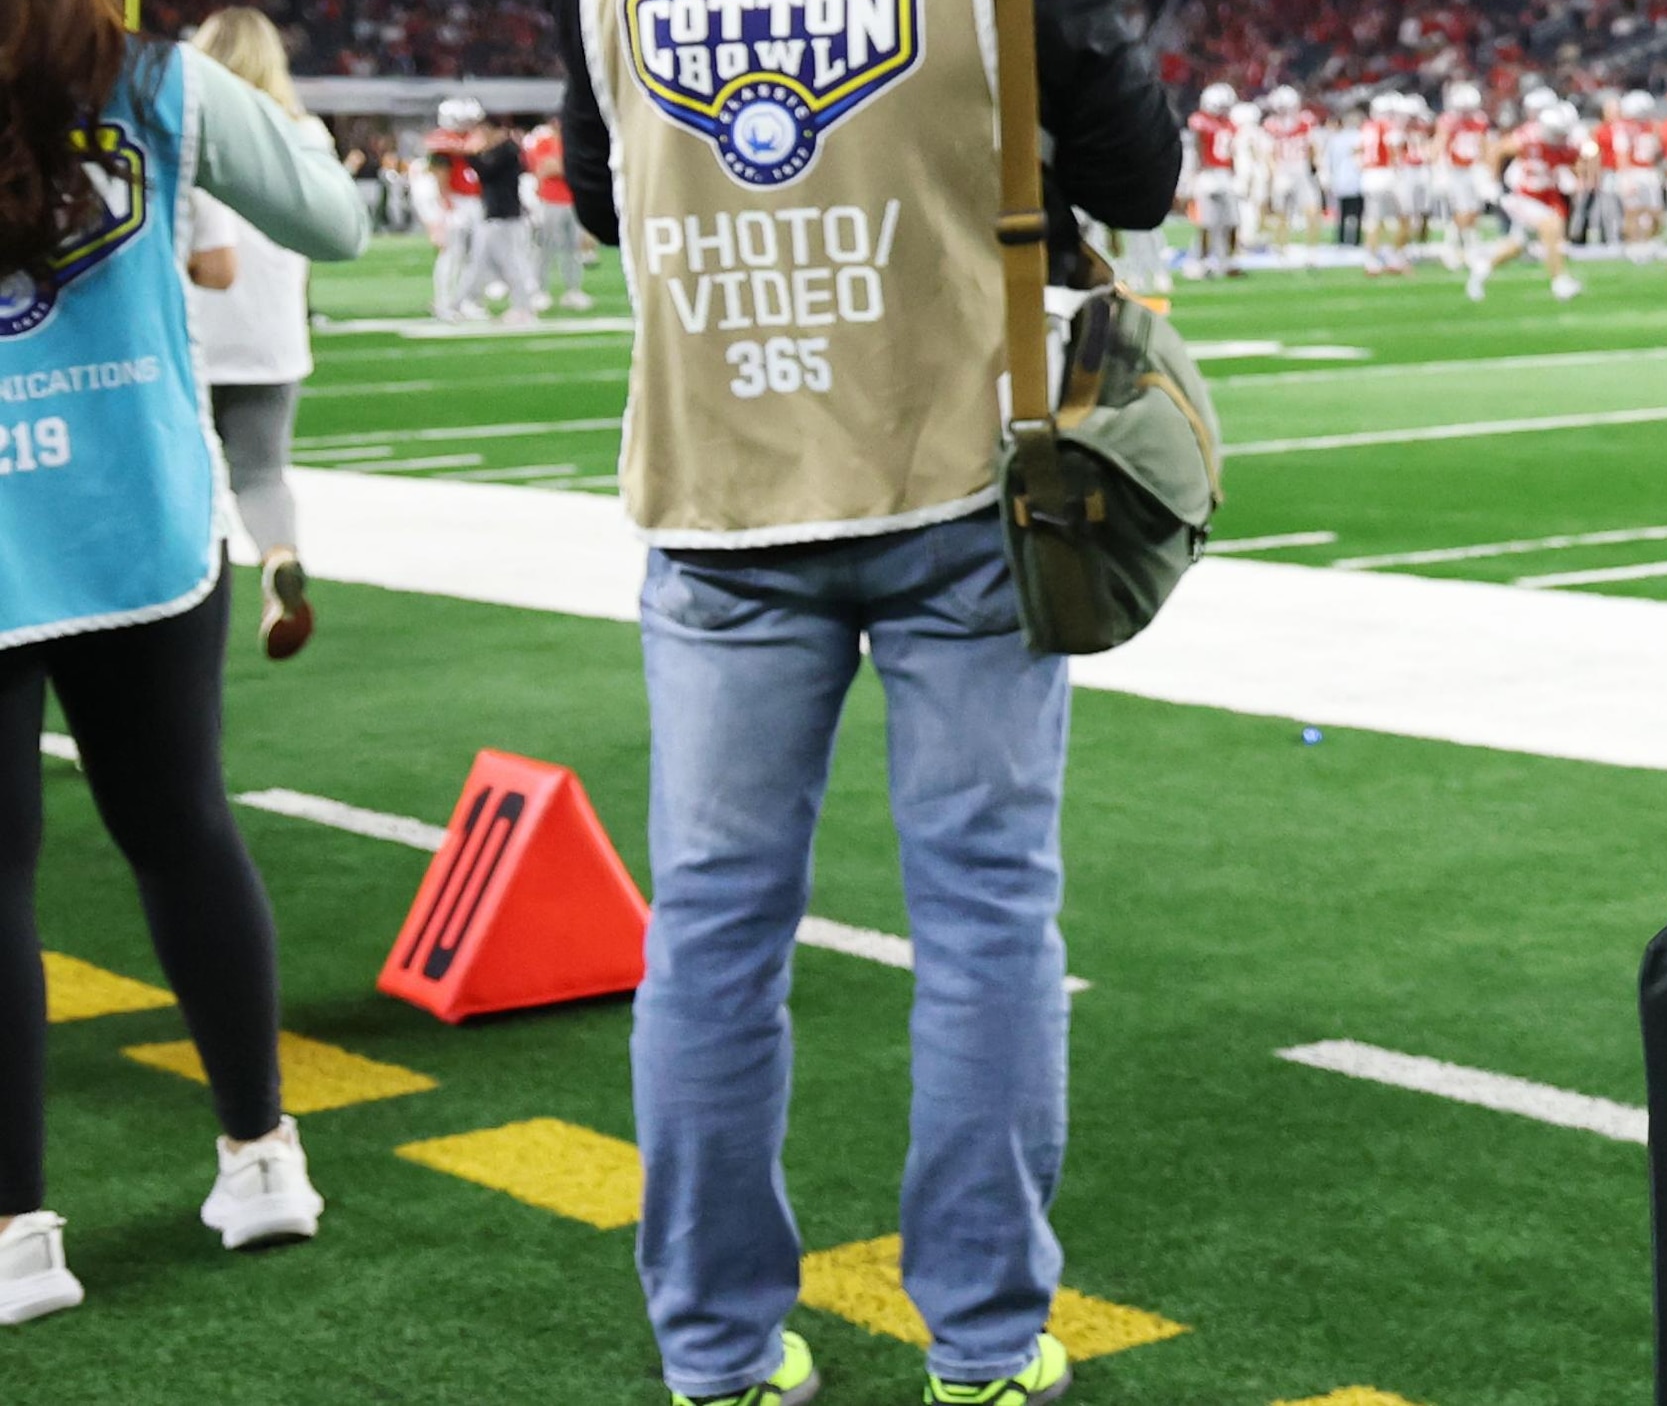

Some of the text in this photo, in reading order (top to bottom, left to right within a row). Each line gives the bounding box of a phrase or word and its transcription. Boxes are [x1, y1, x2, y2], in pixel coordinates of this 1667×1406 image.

[676, 38, 846, 96] BOWL
[644, 199, 901, 275] PHOTO/
[667, 266, 885, 334] VIDEO
[725, 337, 832, 399] 365
